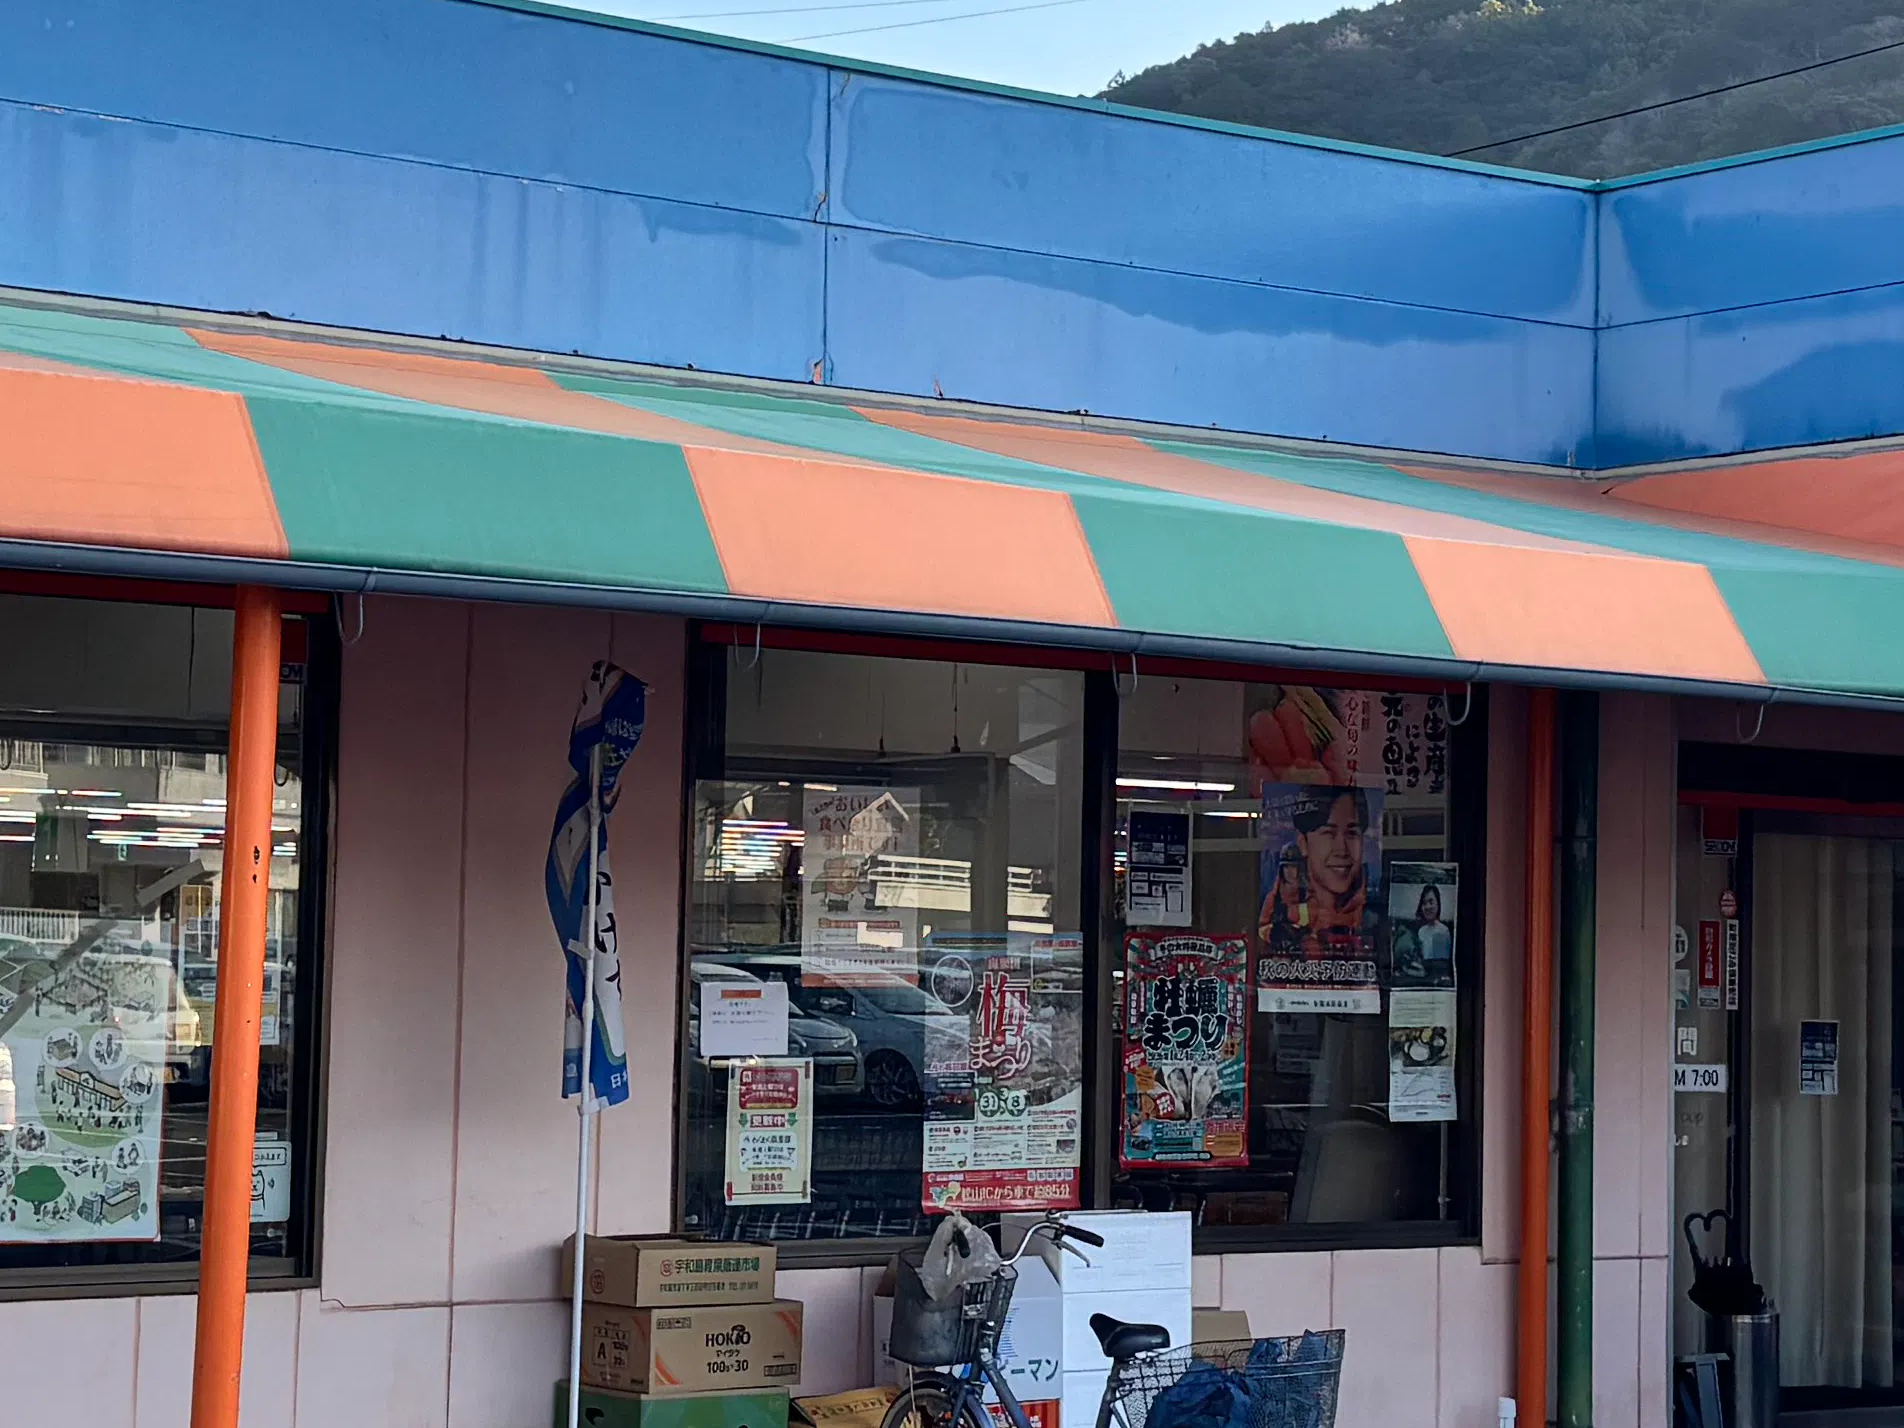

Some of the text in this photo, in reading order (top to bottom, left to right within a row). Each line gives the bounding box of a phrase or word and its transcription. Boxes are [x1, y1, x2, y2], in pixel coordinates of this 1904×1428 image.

[1143, 1012, 1229, 1052] まつり
[1677, 1027, 1698, 1056] 間
[1691, 1069, 1719, 1087] 7:00
[982, 1095, 996, 1110] 31
[1010, 1094, 1021, 1109] 8
